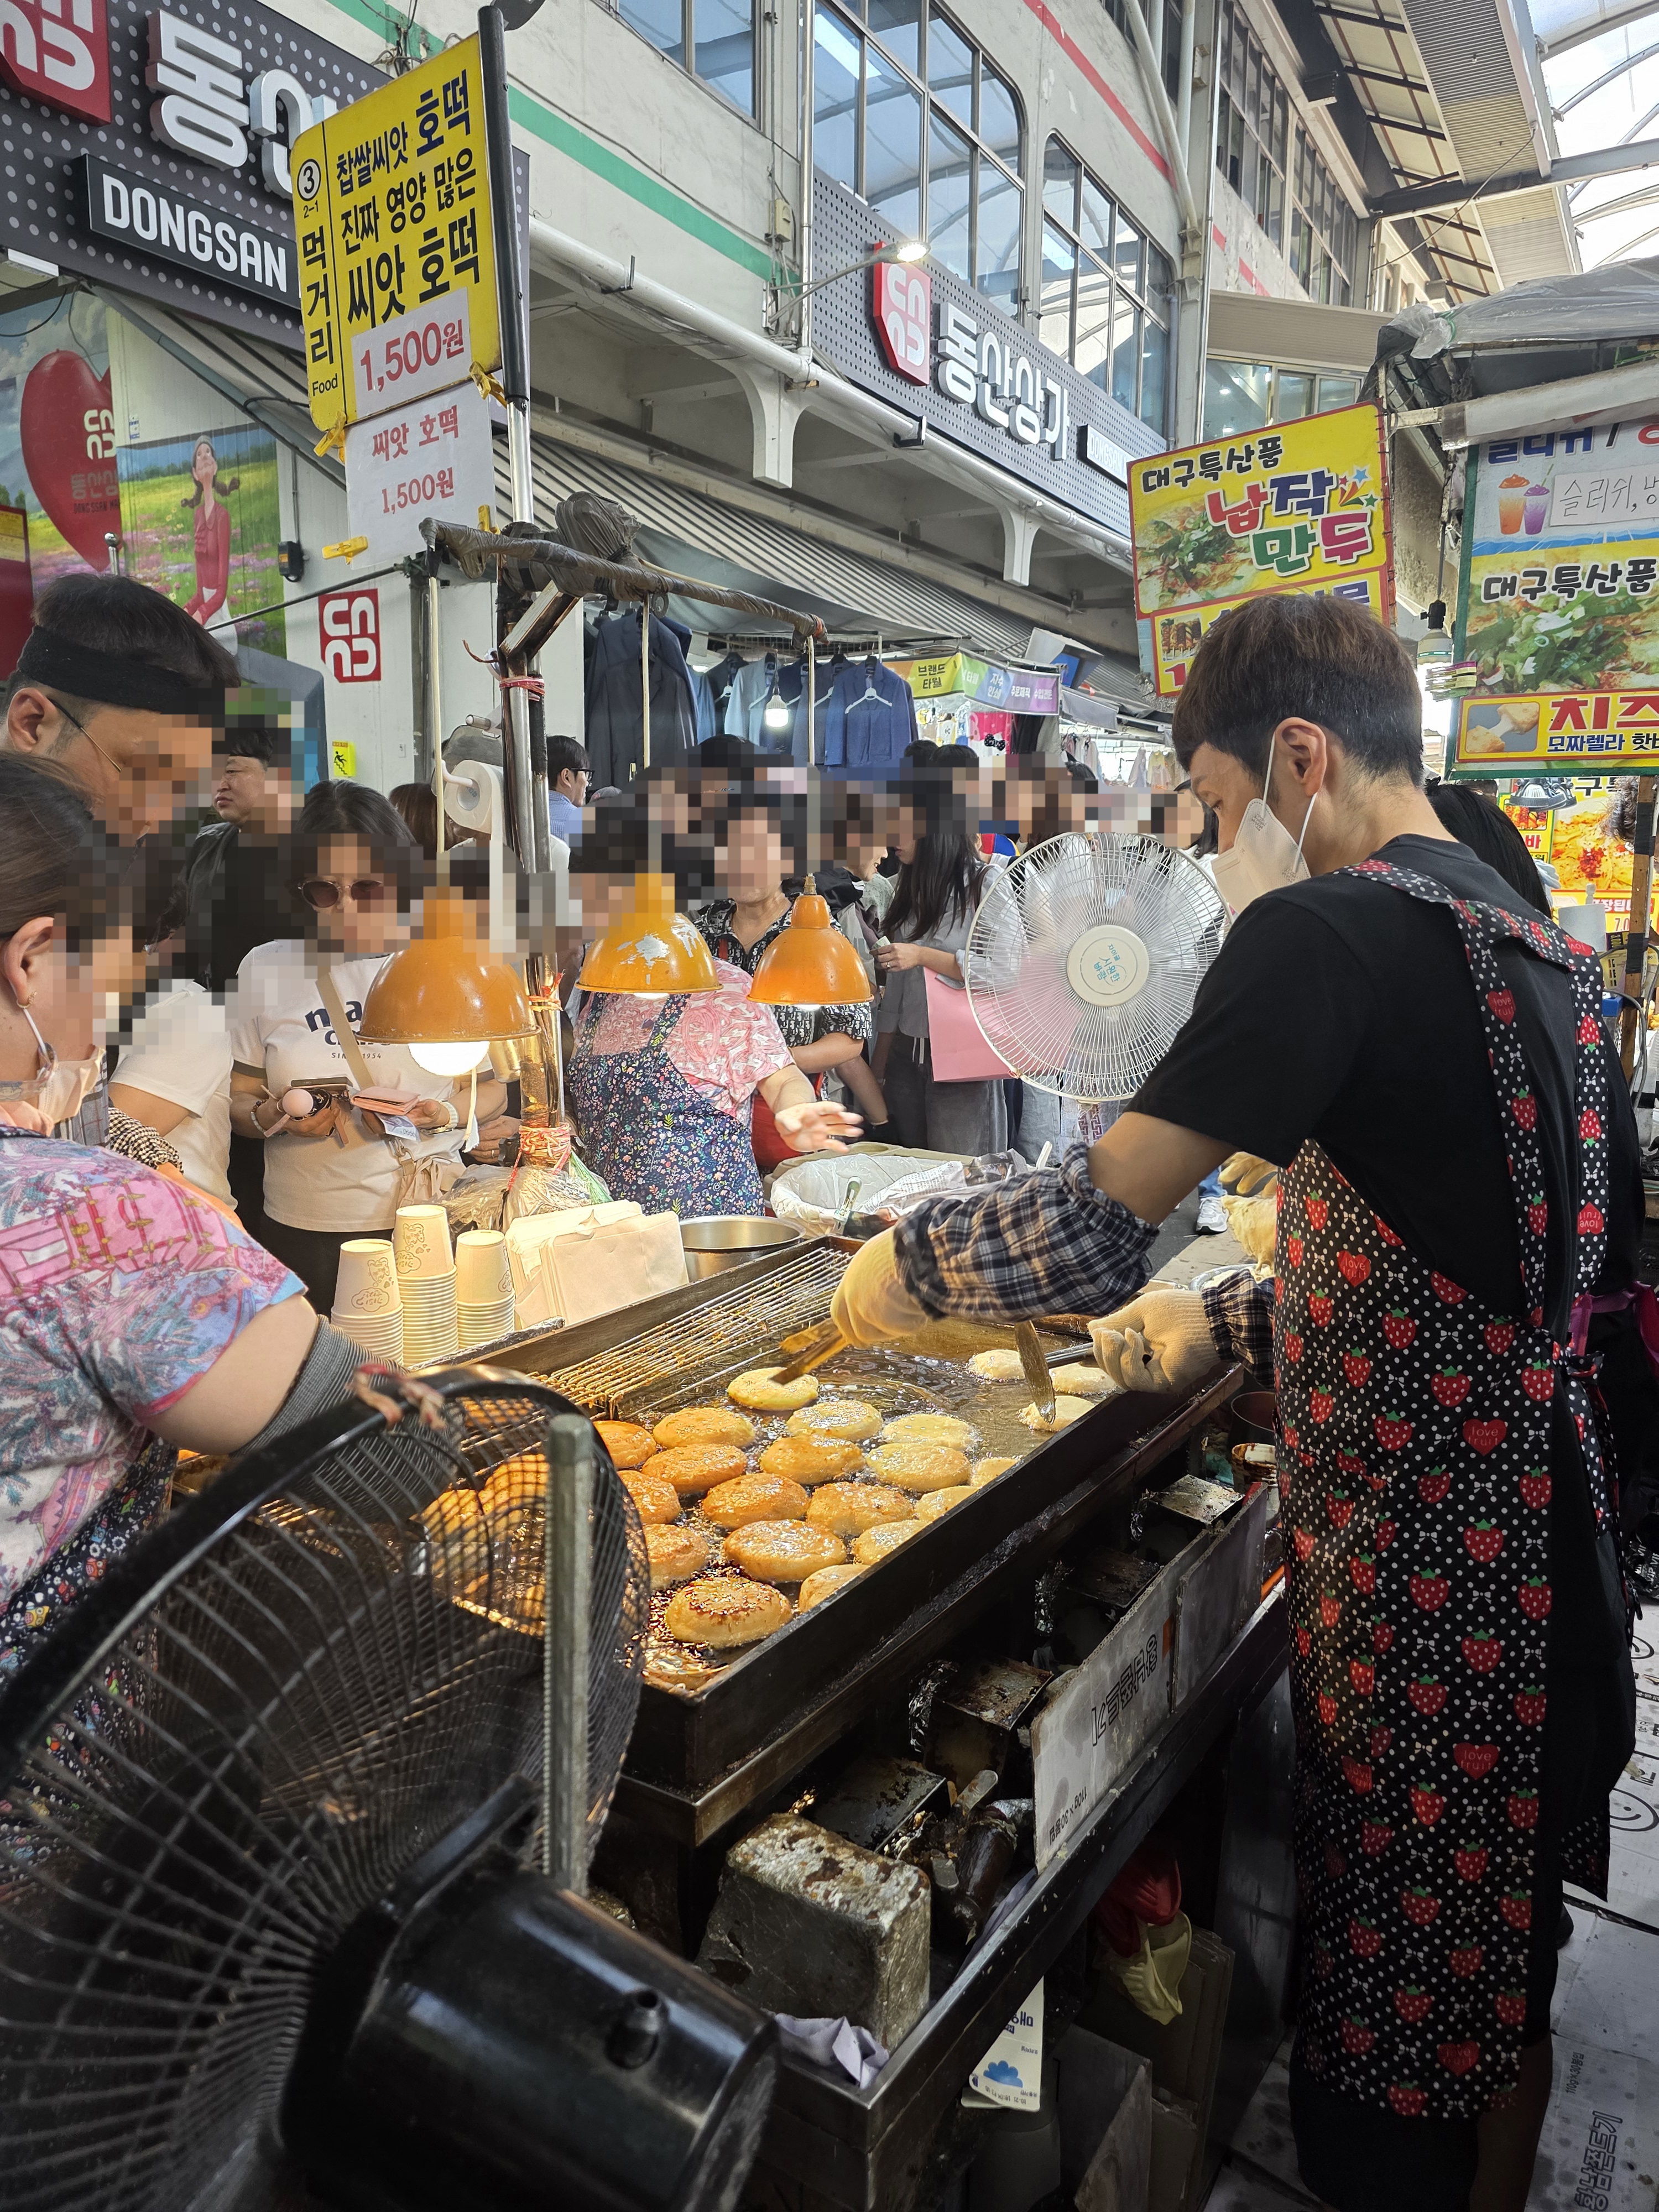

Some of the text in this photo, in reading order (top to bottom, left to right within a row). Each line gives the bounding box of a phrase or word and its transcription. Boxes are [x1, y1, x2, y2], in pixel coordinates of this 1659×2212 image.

[337, 69, 471, 197] 찹쌀씨앗 호떡
[303, 200, 319, 218] 2-1
[341, 148, 476, 255] 진짜 영양 많은
[102, 174, 287, 293] DONGSAN
[348, 207, 481, 328] 씨앗 호떡
[360, 319, 465, 393] 1,500원
[312, 374, 338, 397] Food
[938, 301, 1070, 461] 동산상가
[372, 405, 459, 462] 씨앗 호떡
[1142, 436, 1283, 492] 대구특산품
[71, 468, 119, 500] 동산상
[382, 467, 454, 515] 1,500원
[1206, 469, 1335, 535] 납작
[1253, 513, 1369, 572] 만두
[1484, 559, 1657, 601] 대구특산품
[918, 664, 946, 676] 브랜드
[990, 673, 1004, 686] 자수
[922, 677, 942, 689] 타월
[1011, 685, 1031, 698] 주문제작
[1547, 734, 1625, 752] 모짜렐라
[1107, 943, 1121, 962] 자이글
[1093, 962, 1107, 980] 바람
[1102, 958, 1120, 983] 시원한
[1493, 997, 1511, 1006] love
[1579, 1220, 1598, 1229] love
[1345, 1257, 1365, 1270] love
[1472, 1426, 1499, 1437] love
[1091, 1634, 1158, 1746] 황남쫀드기
[1464, 1751, 1491, 1761] love
